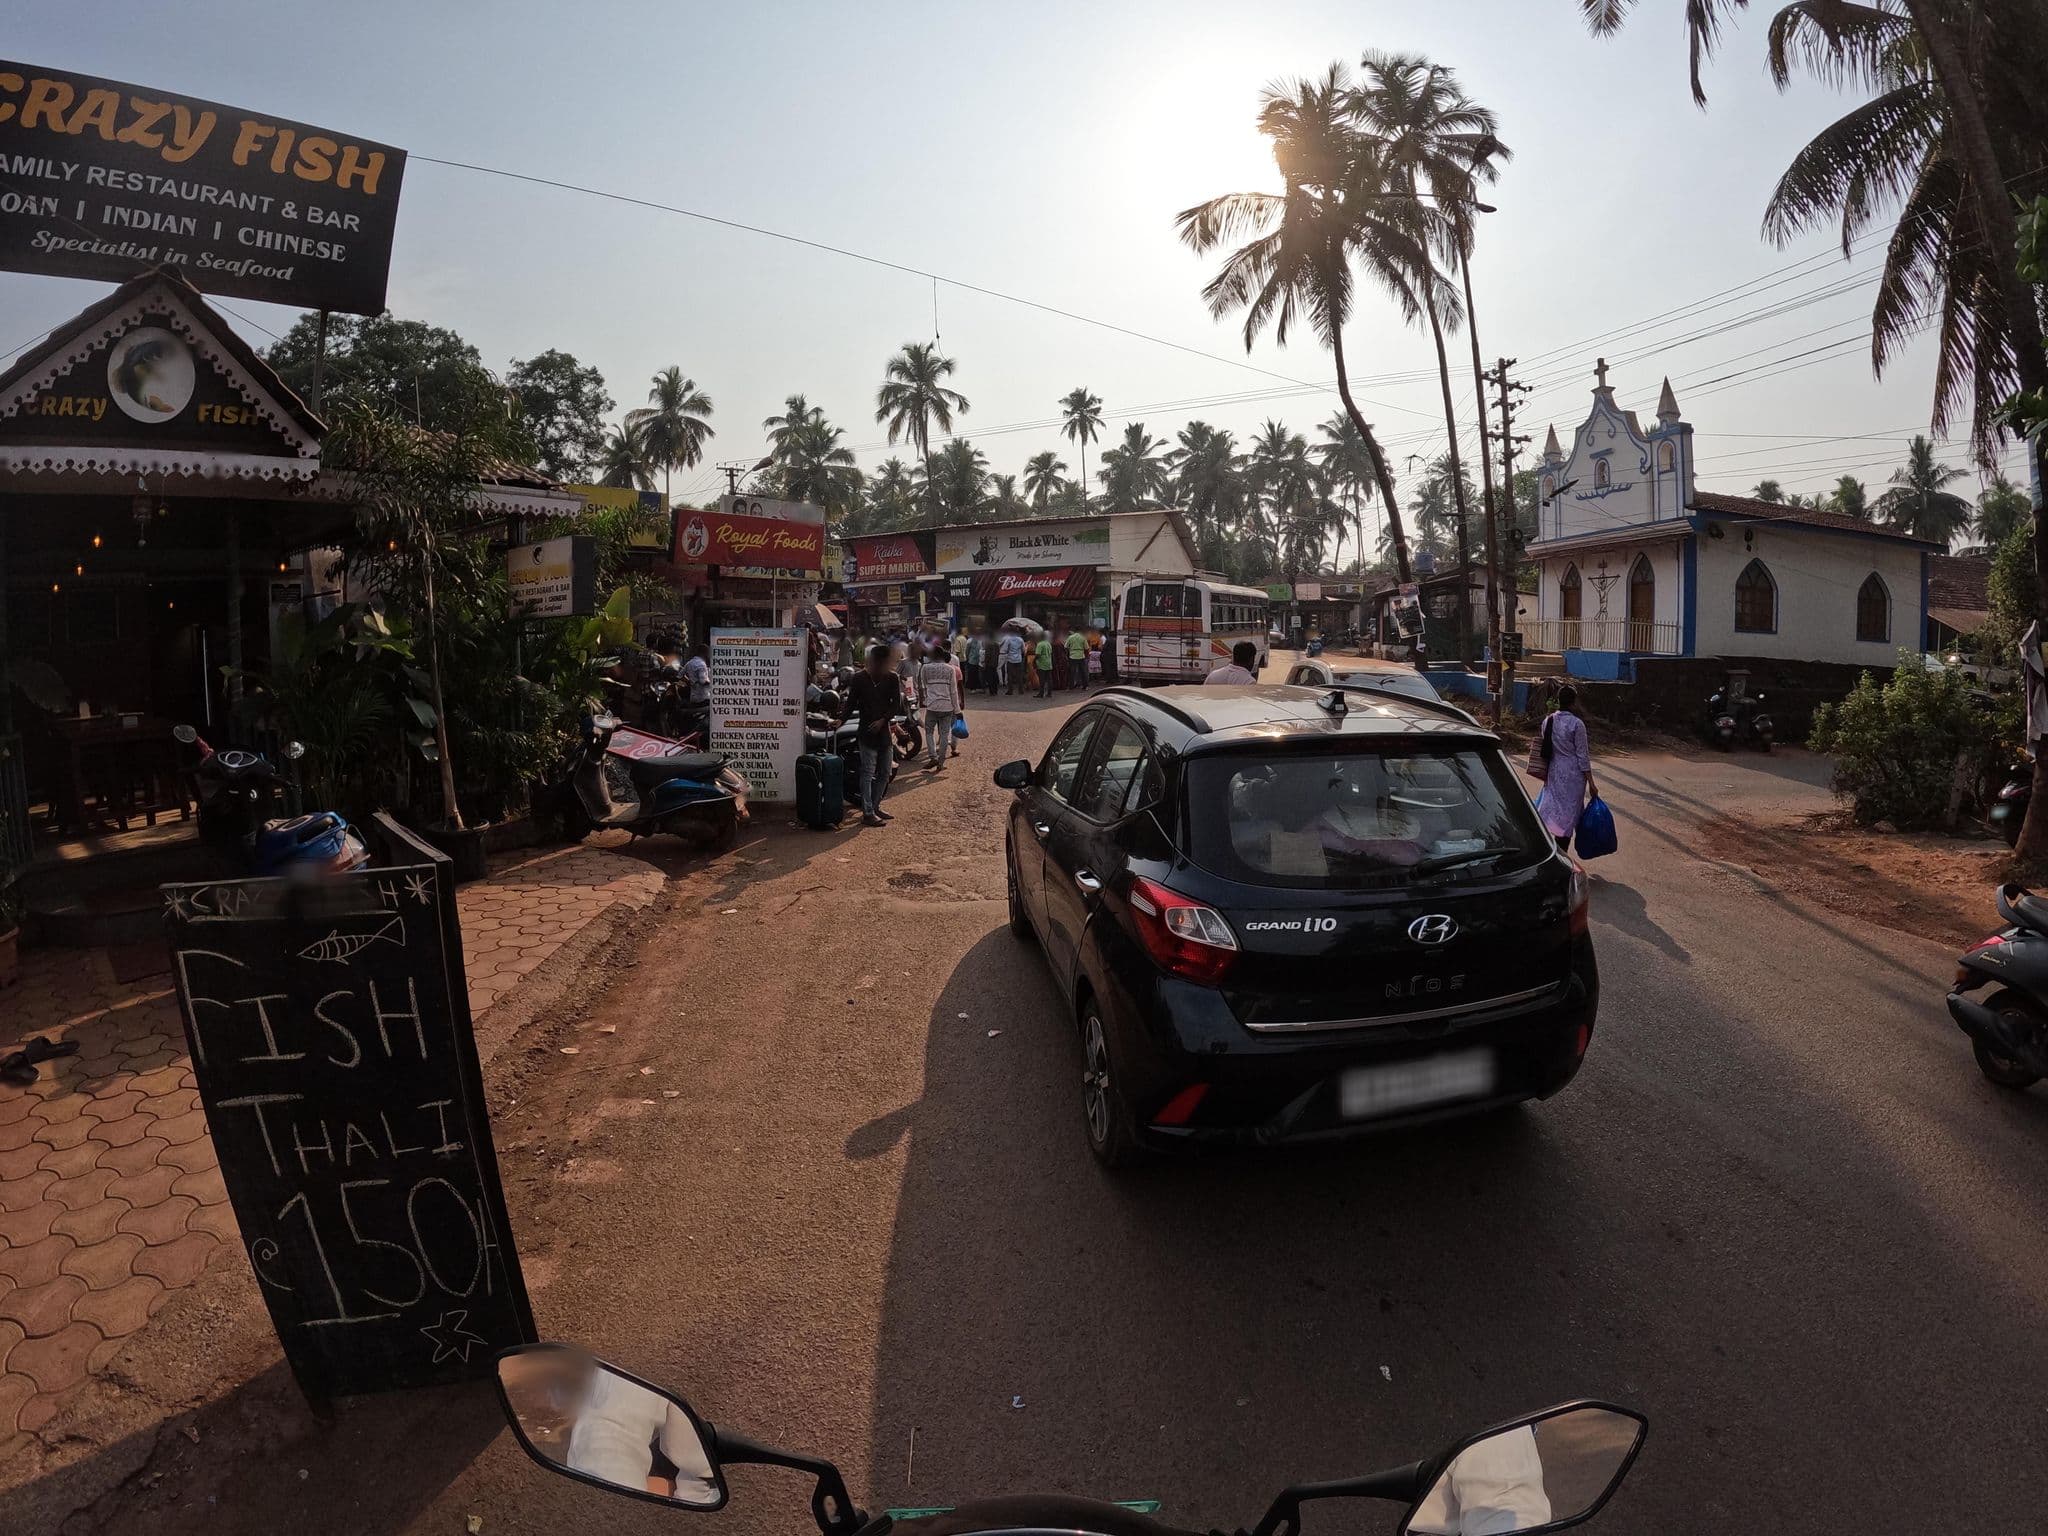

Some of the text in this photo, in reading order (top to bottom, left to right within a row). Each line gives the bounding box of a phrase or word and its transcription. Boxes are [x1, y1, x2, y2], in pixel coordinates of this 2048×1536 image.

[231, 119, 386, 195] FISH
[86, 166, 275, 215] RESTAURANT
[281, 201, 298, 220] &
[307, 206, 361, 233] BAR
[0, 192, 59, 218] OAN
[102, 204, 198, 236] INDIAN
[237, 225, 347, 263] CHINESE
[31, 230, 296, 282] Specialist in Seafood
[196, 401, 259, 426] FISH
[715, 522, 770, 553] Royal
[773, 528, 817, 552] Foods
[859, 561, 927, 577] SUPER MARKET
[949, 577, 971, 586] SIRSAT
[998, 574, 1066, 590] Budweiser
[950, 588, 970, 597] WINES
[713, 648, 731, 657] FISH
[734, 648, 759, 657] THALI
[713, 658, 780, 667] POMFRET THALI
[713, 668, 779, 677] KINGFISH THALI
[713, 678, 779, 686] PRAWNS THALI
[713, 687, 779, 696] CHONAK THALI
[713, 697, 750, 706] CHICKEN
[753, 698, 778, 706] THALI
[713, 707, 730, 715] VEG
[733, 707, 759, 715] THALI
[711, 732, 780, 741] CHICKEN CAFREAL
[711, 741, 780, 750] CHICKEN BIRYANI
[740, 751, 769, 760] SUKHA
[746, 761, 773, 769] SUKHA
[749, 771, 779, 779] CHILLY
[1245, 920, 1302, 932] GRAND
[176, 949, 428, 1070] FISH
[216, 1093, 465, 1177] THALI
